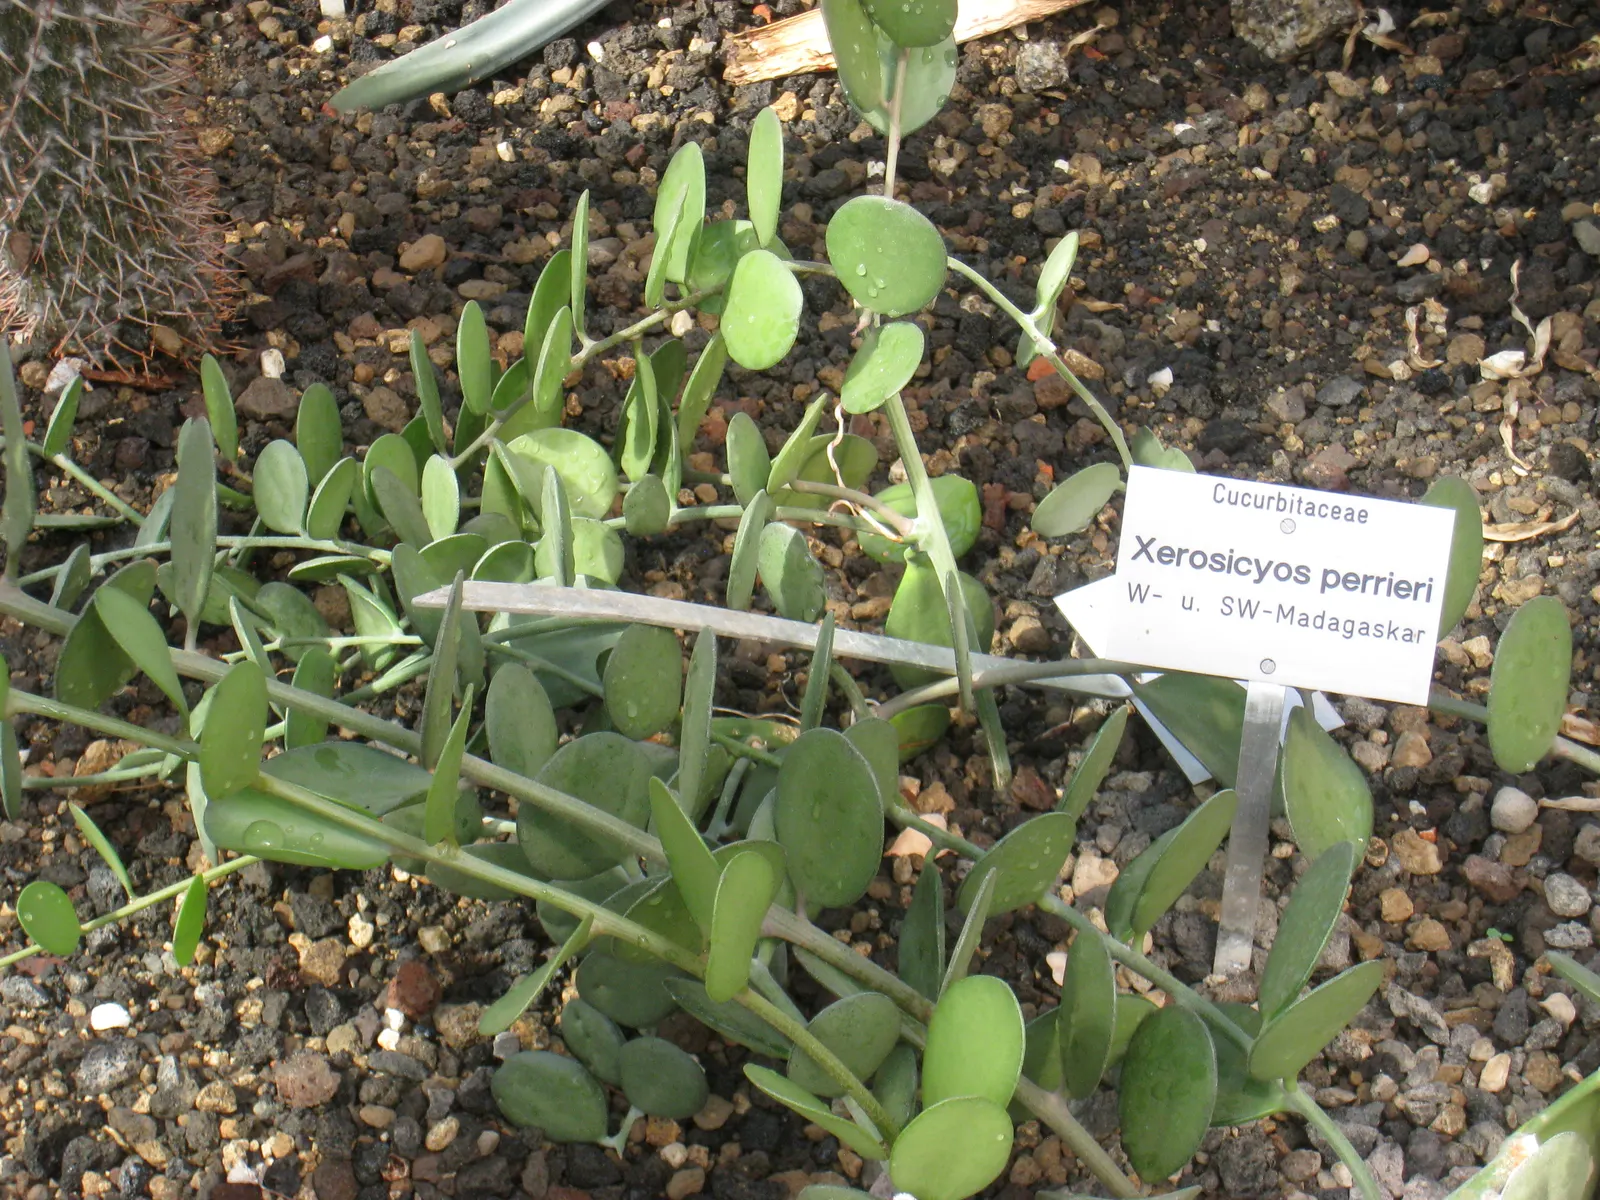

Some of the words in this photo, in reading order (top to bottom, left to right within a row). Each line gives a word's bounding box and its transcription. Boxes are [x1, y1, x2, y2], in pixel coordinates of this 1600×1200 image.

[1212, 482, 1370, 525] Cucurbitaceae
[1130, 535, 1312, 585] Xerosicyos
[1319, 567, 1434, 603] perrieri
[1127, 581, 1163, 604] W-
[1181, 594, 1201, 612] u.
[1220, 596, 1426, 645] SW-Madagaskar
